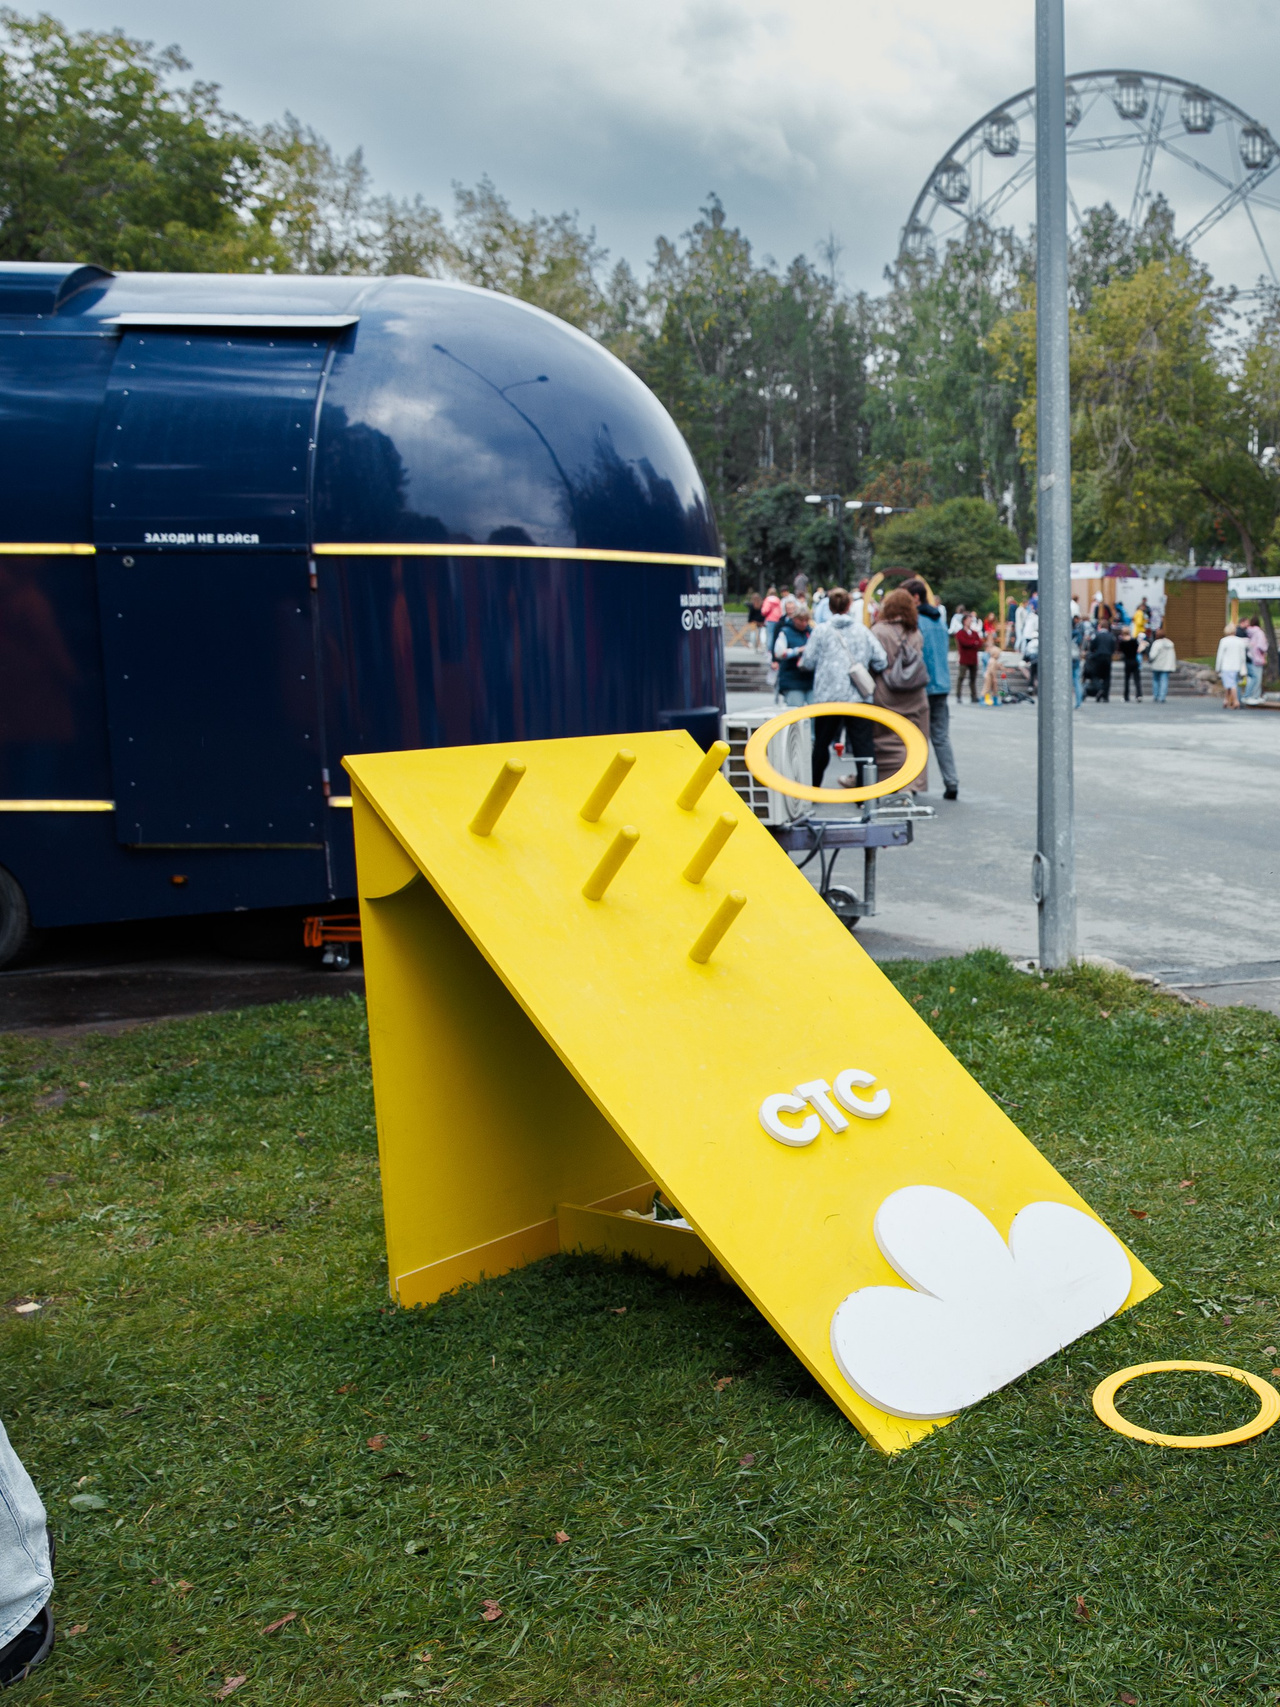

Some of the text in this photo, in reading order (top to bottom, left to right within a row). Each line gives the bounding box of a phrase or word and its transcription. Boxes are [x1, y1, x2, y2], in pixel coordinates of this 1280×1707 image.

[144, 532, 260, 545] ЗАХОДИ НЕ БОЙСЯ
[758, 1068, 892, 1148] СТС
